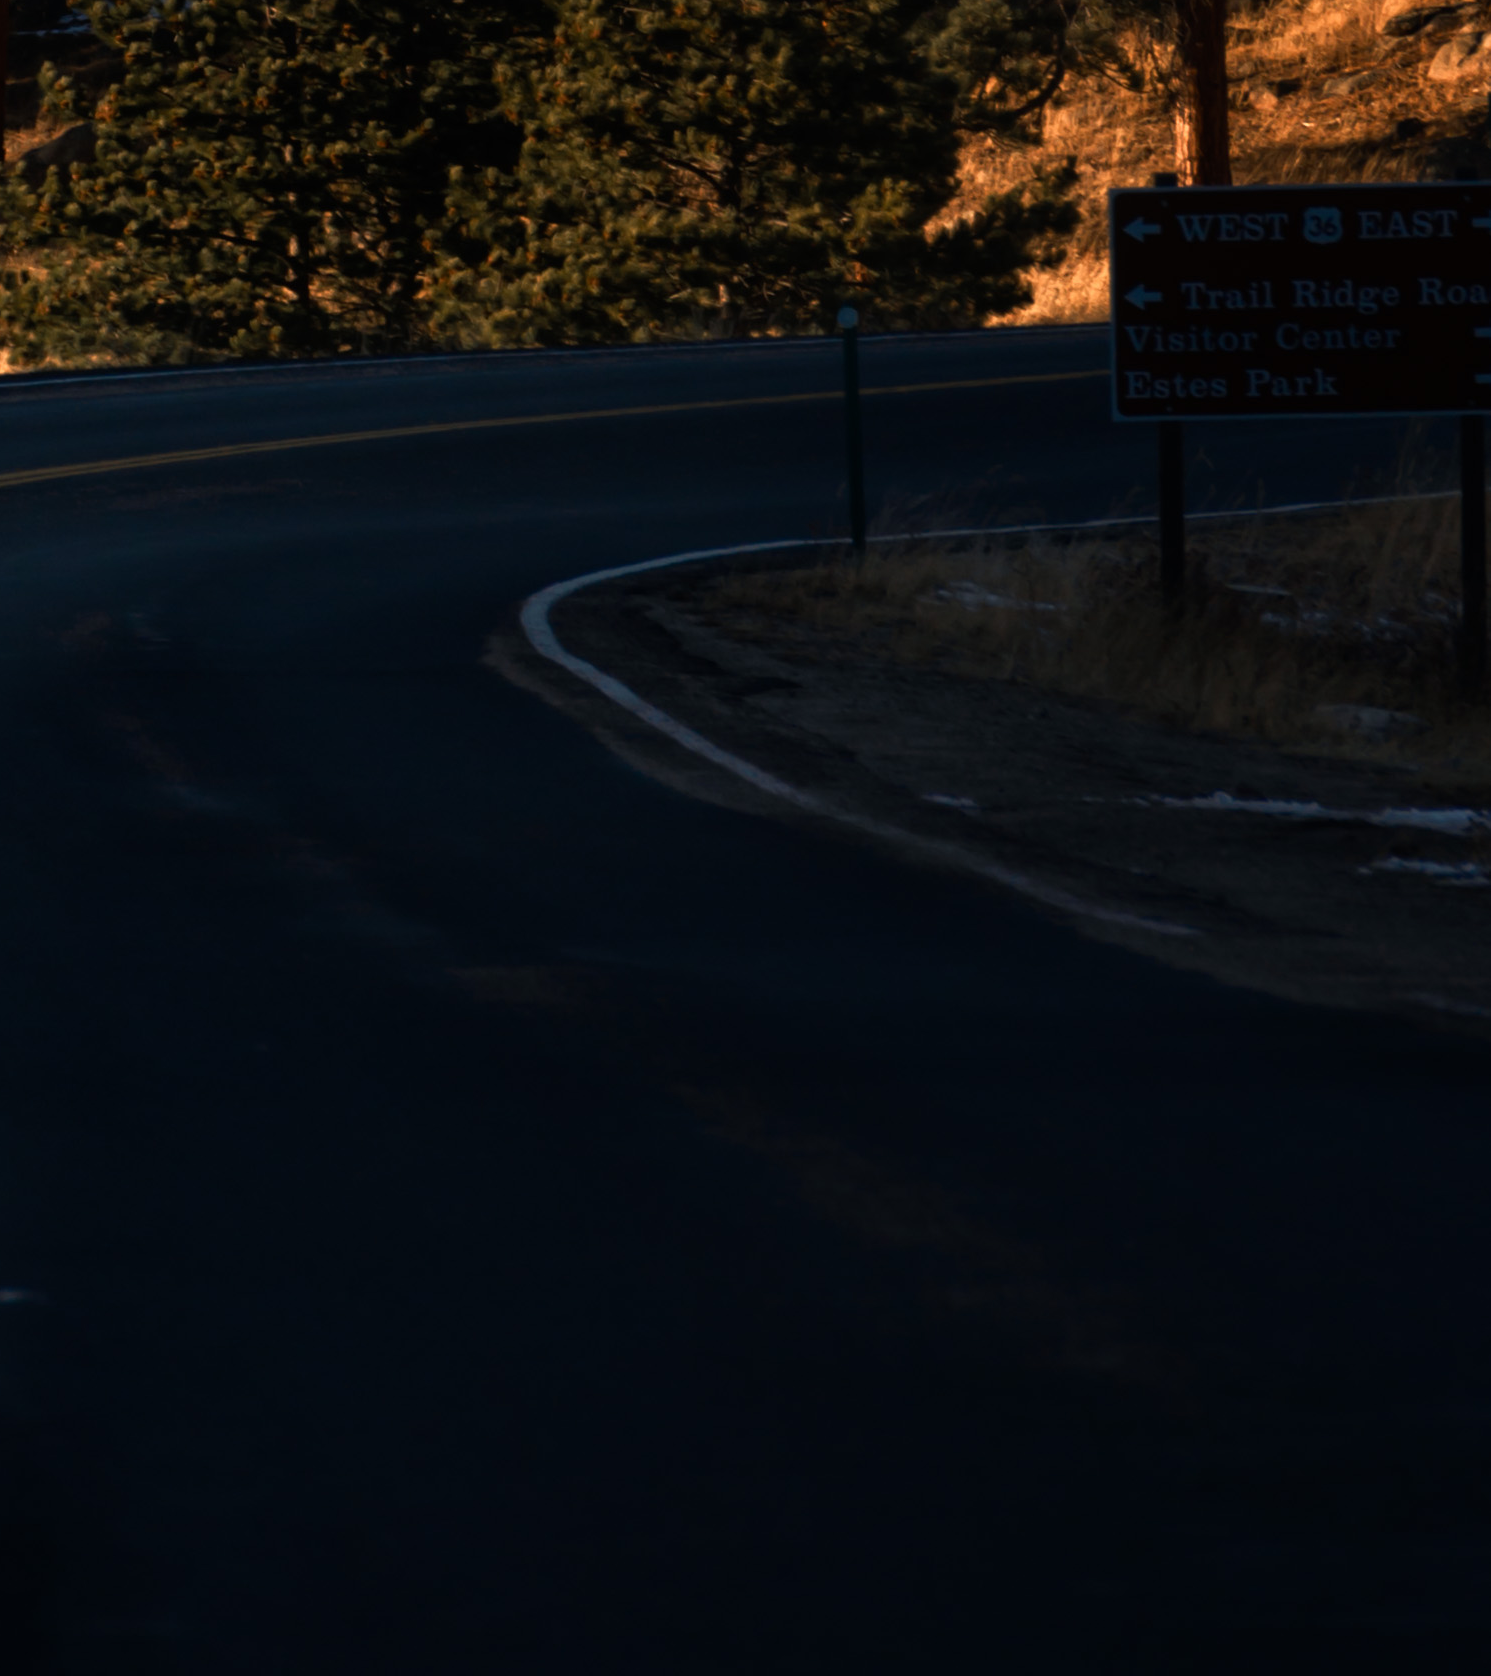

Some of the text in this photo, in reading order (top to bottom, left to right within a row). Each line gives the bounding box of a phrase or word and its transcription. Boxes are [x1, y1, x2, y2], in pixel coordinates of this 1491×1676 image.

[1176, 209, 1459, 243] WEST 36 EAST
[1180, 277, 1491, 315] Trail Ridge Roa
[1124, 321, 1401, 353] Visitor Center
[1124, 367, 1340, 400] Estes Park
